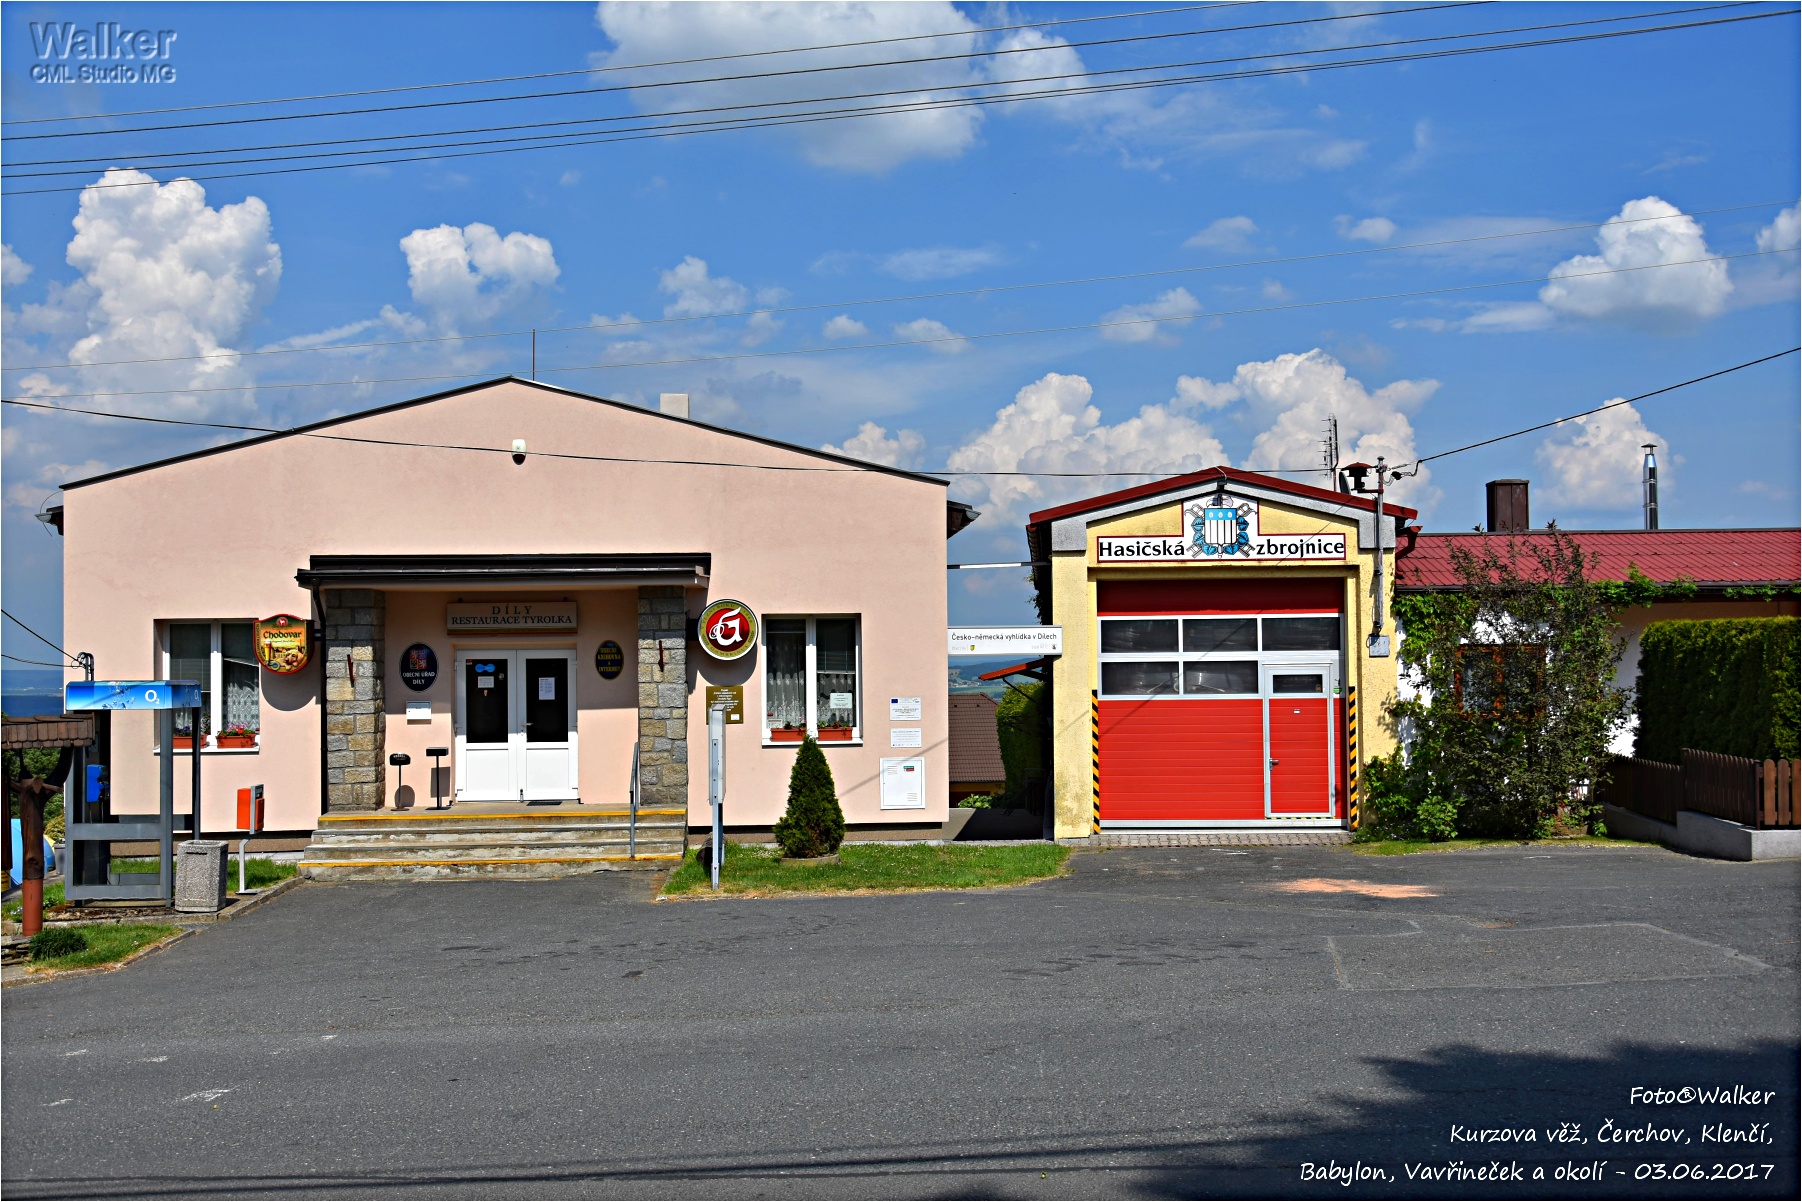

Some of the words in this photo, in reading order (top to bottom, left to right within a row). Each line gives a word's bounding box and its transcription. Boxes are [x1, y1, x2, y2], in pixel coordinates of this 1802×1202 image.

[1099, 540, 1185, 557] Hasičská
[1256, 538, 1345, 558] zbrojnice
[492, 604, 532, 615] DÍLY
[452, 616, 520, 625] RESTAURACE
[522, 615, 572, 624] TYROLKA
[263, 630, 302, 639] Chodovar
[951, 632, 1004, 641] Česko-německá
[1005, 633, 1032, 641] vyhlídka
[1037, 632, 1057, 640] Dílech
